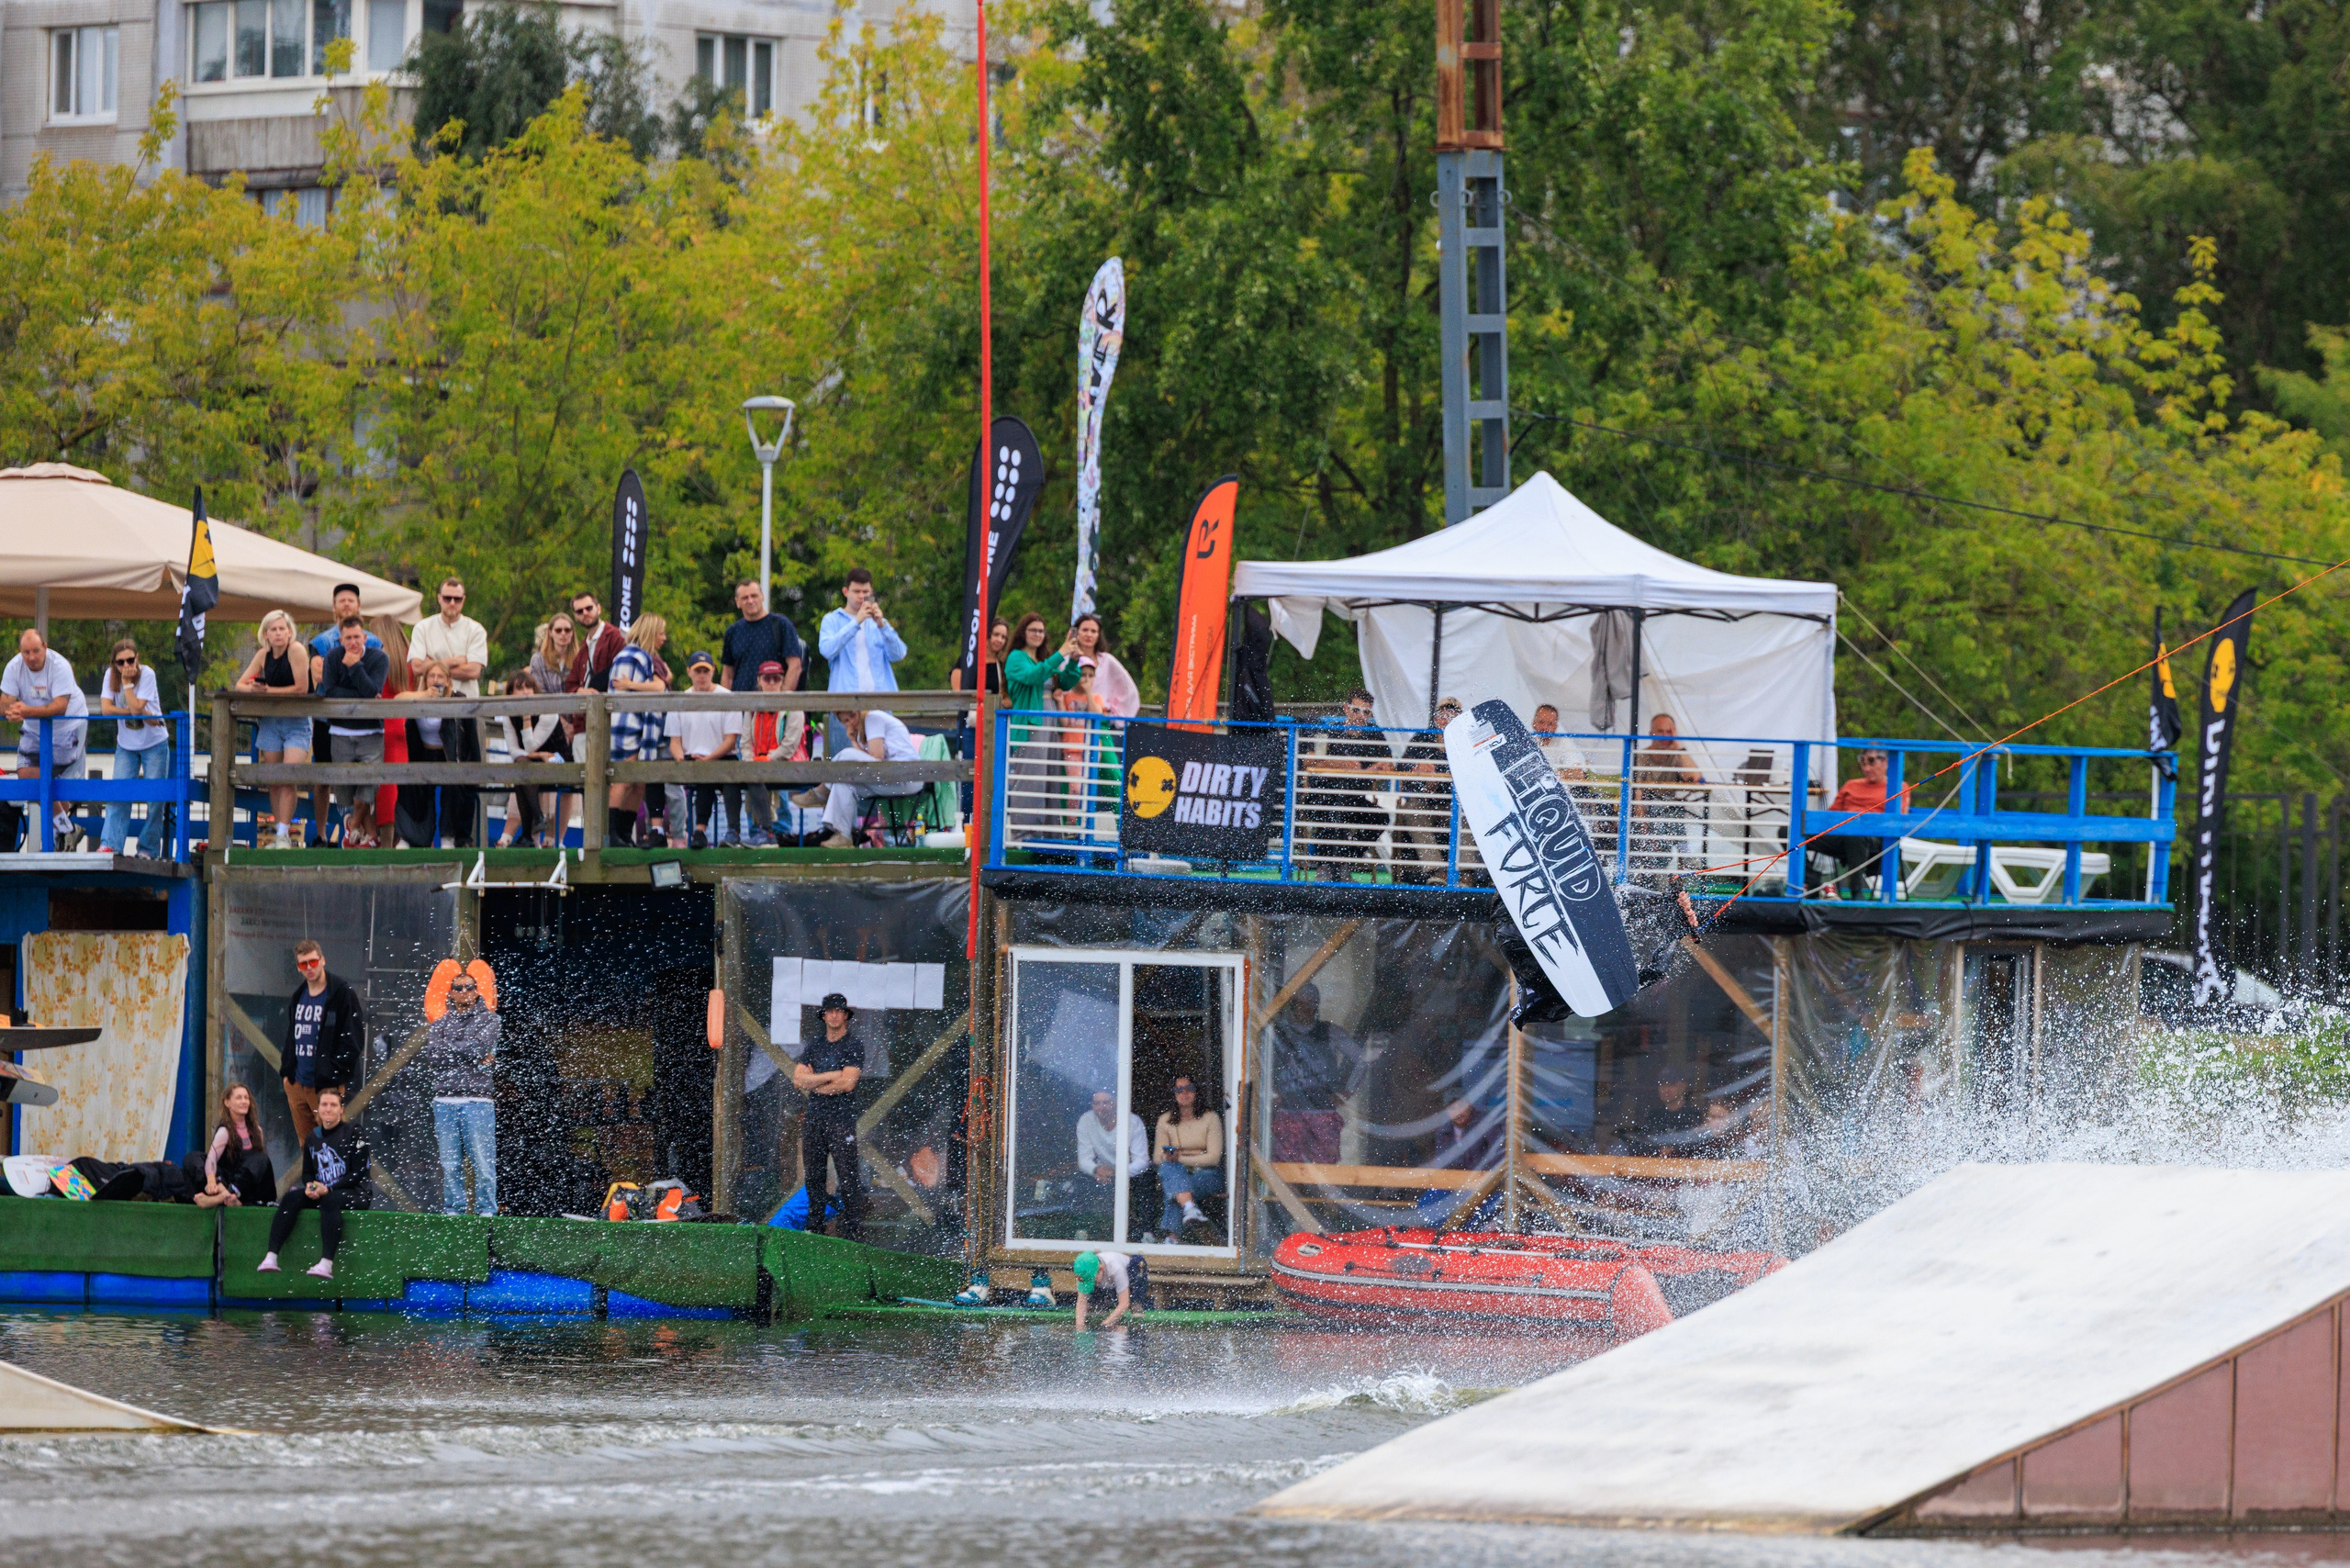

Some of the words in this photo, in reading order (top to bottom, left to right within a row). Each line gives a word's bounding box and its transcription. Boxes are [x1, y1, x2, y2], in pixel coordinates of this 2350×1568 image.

[1179, 760, 1270, 799] DIRTY
[1173, 796, 1262, 829] HABITS
[1483, 811, 1579, 969] FORCE
